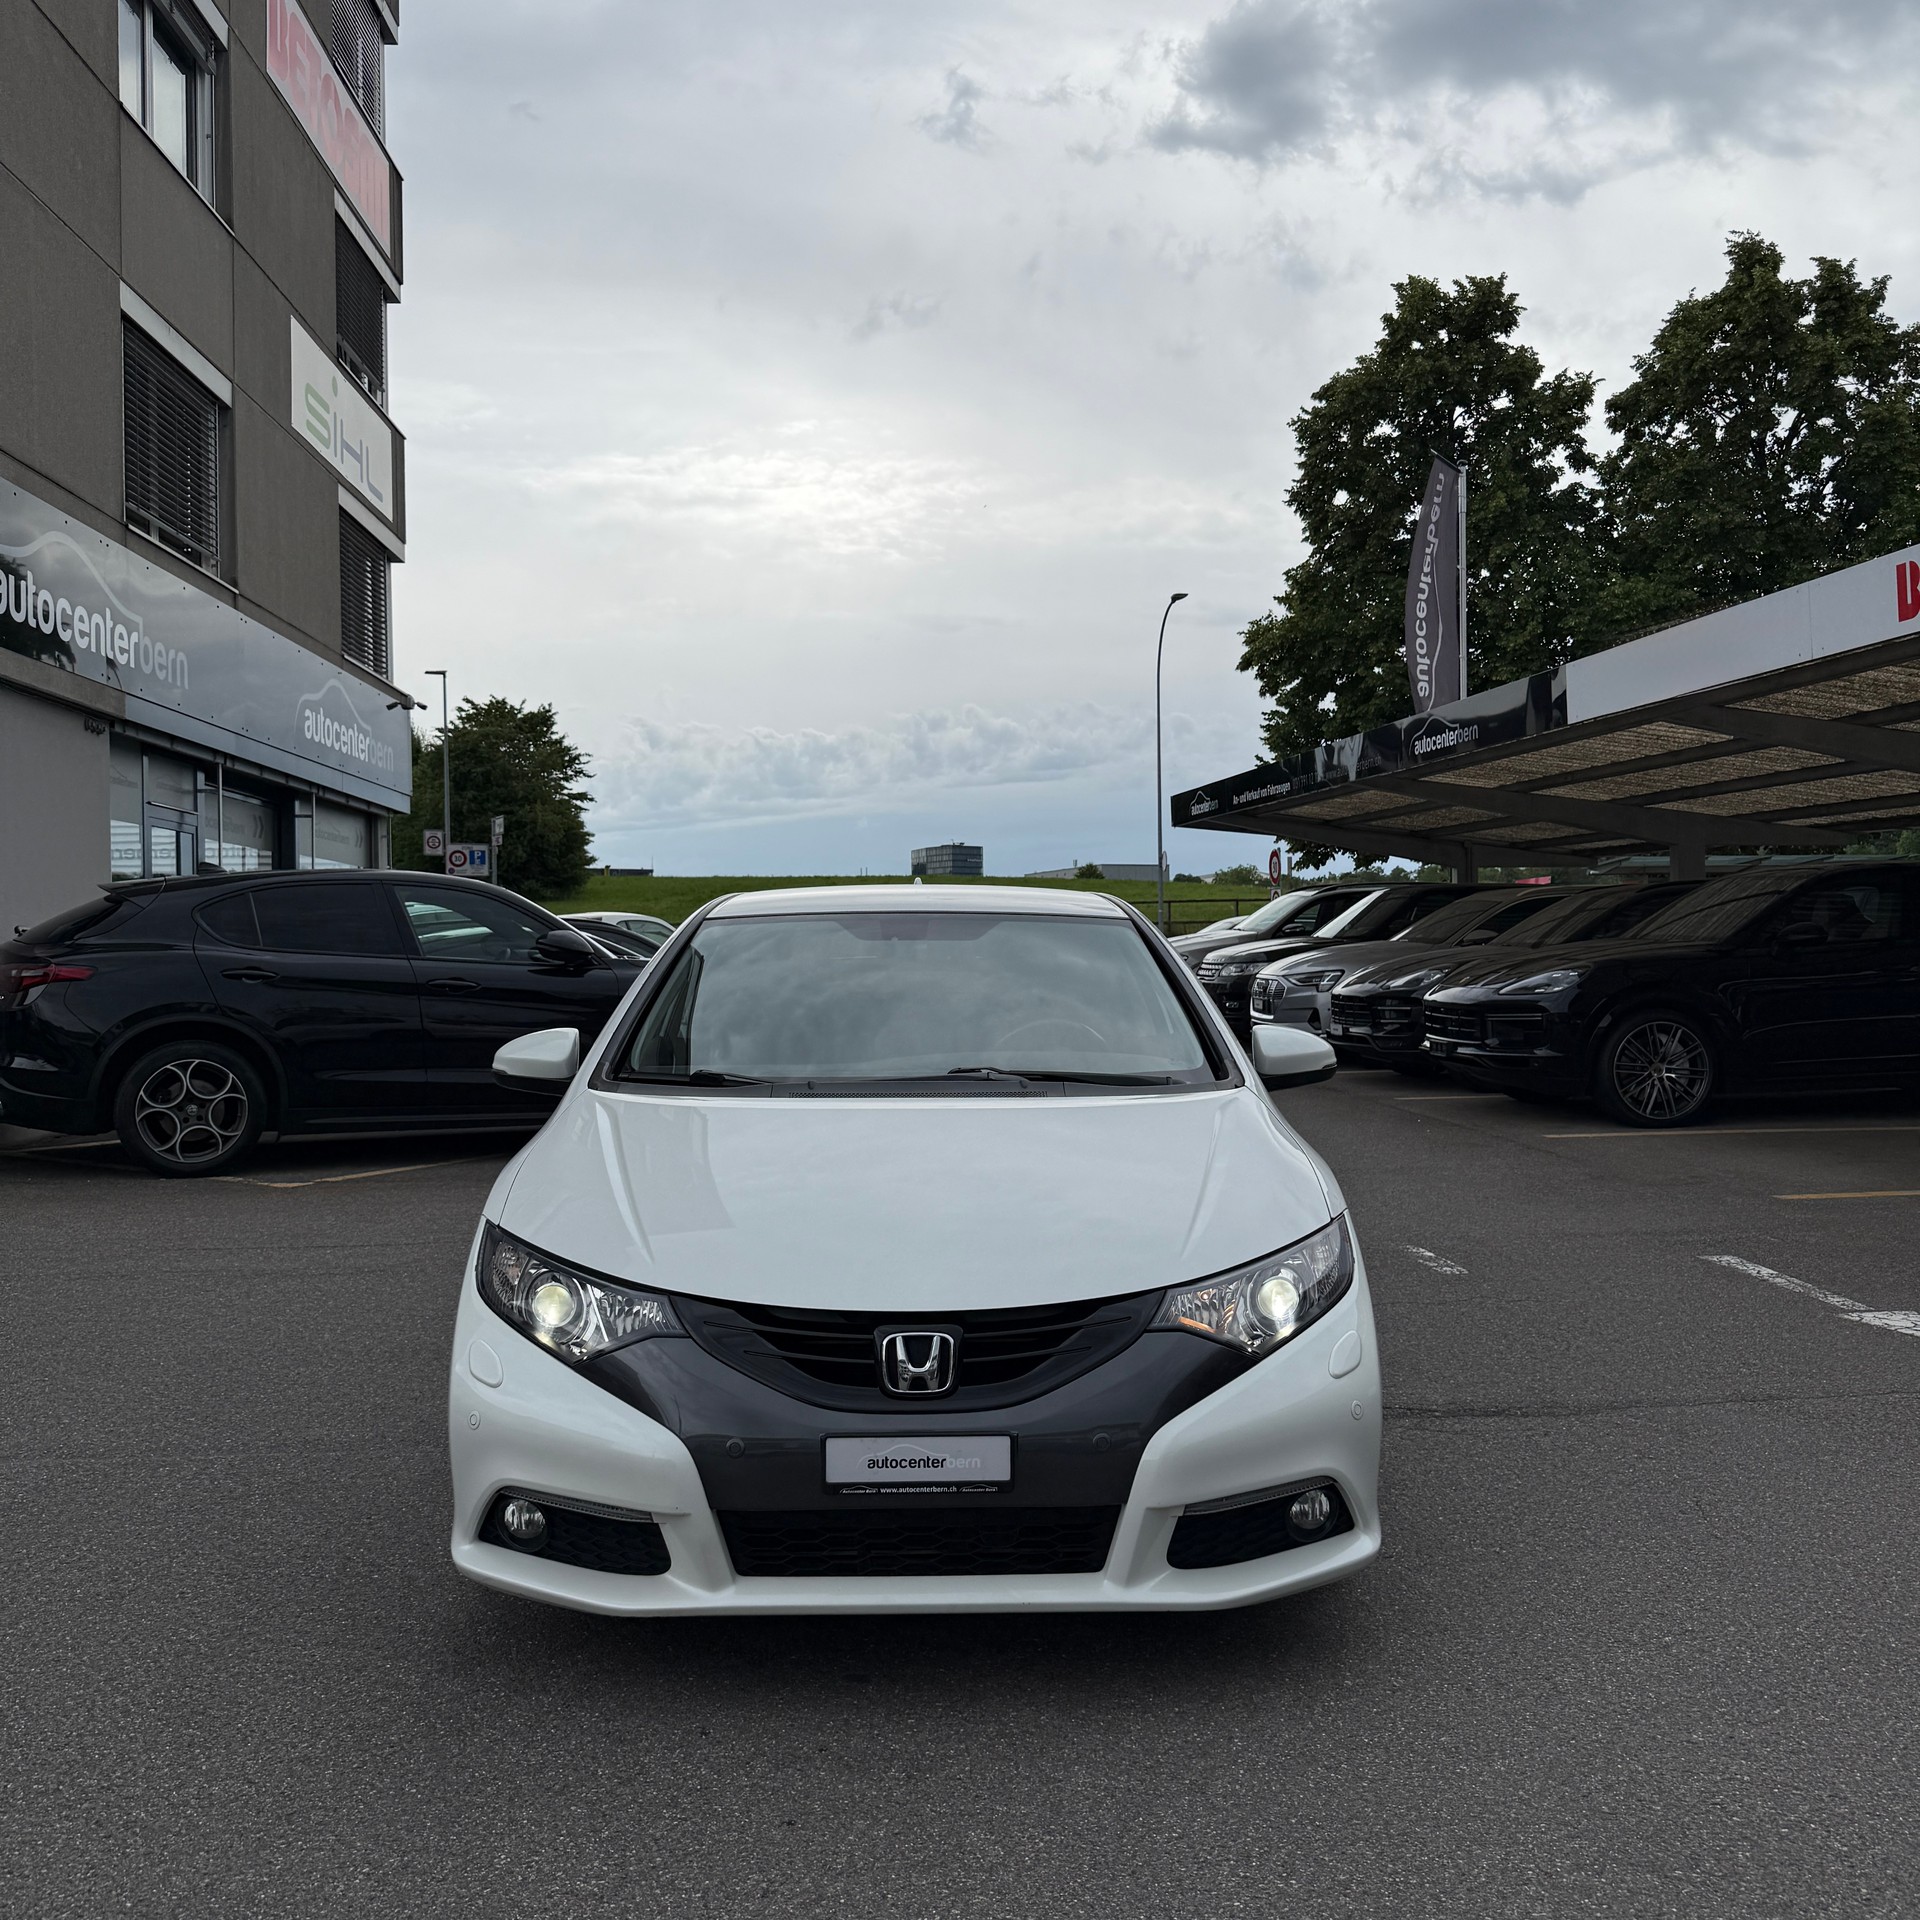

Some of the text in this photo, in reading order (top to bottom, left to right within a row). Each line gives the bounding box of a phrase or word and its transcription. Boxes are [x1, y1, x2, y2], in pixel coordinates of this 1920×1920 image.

[304, 707, 394, 772] autocenterbern
[1414, 724, 1478, 755] autocenterbern
[867, 1455, 981, 1469] autocenterbern
[880, 1486, 957, 1494] www.autocenterbern.ch
